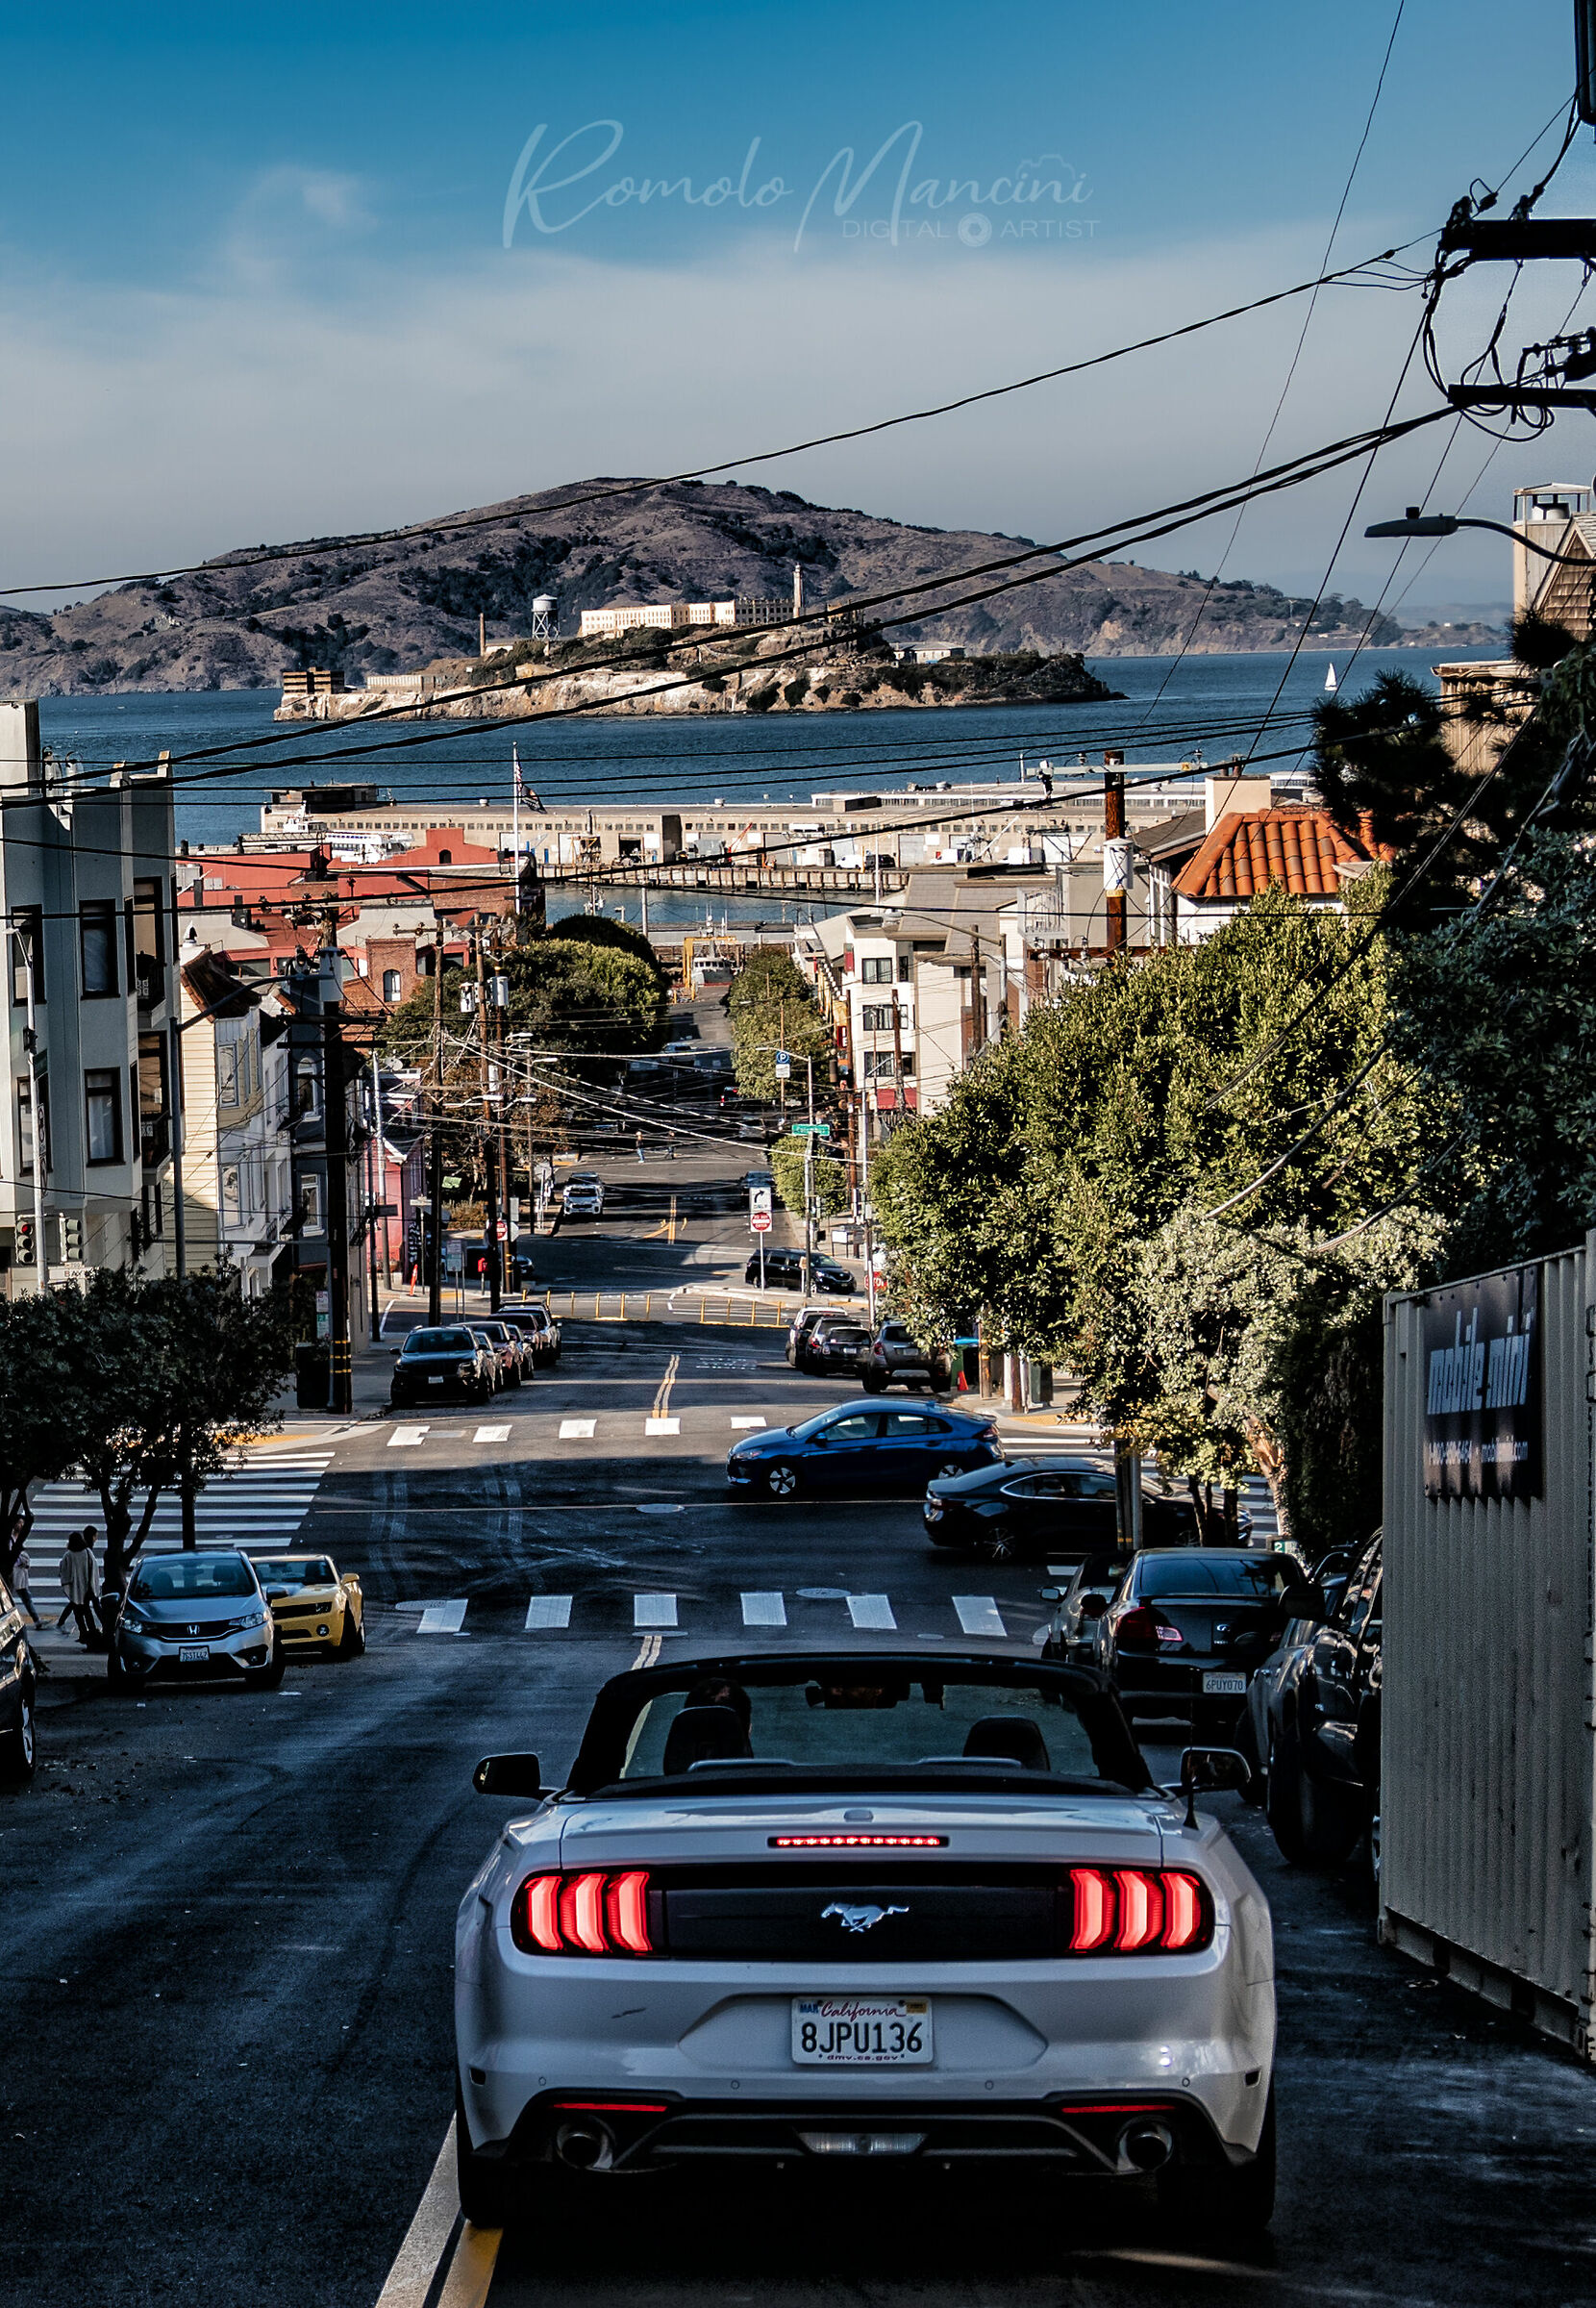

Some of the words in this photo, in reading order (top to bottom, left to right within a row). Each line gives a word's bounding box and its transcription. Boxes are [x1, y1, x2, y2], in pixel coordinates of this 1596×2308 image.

[1427, 1307, 1485, 1416] mobile
[1485, 1312, 1532, 1410] mini
[821, 2000, 907, 2022] California
[801, 2022, 923, 2053] 8JPU136
